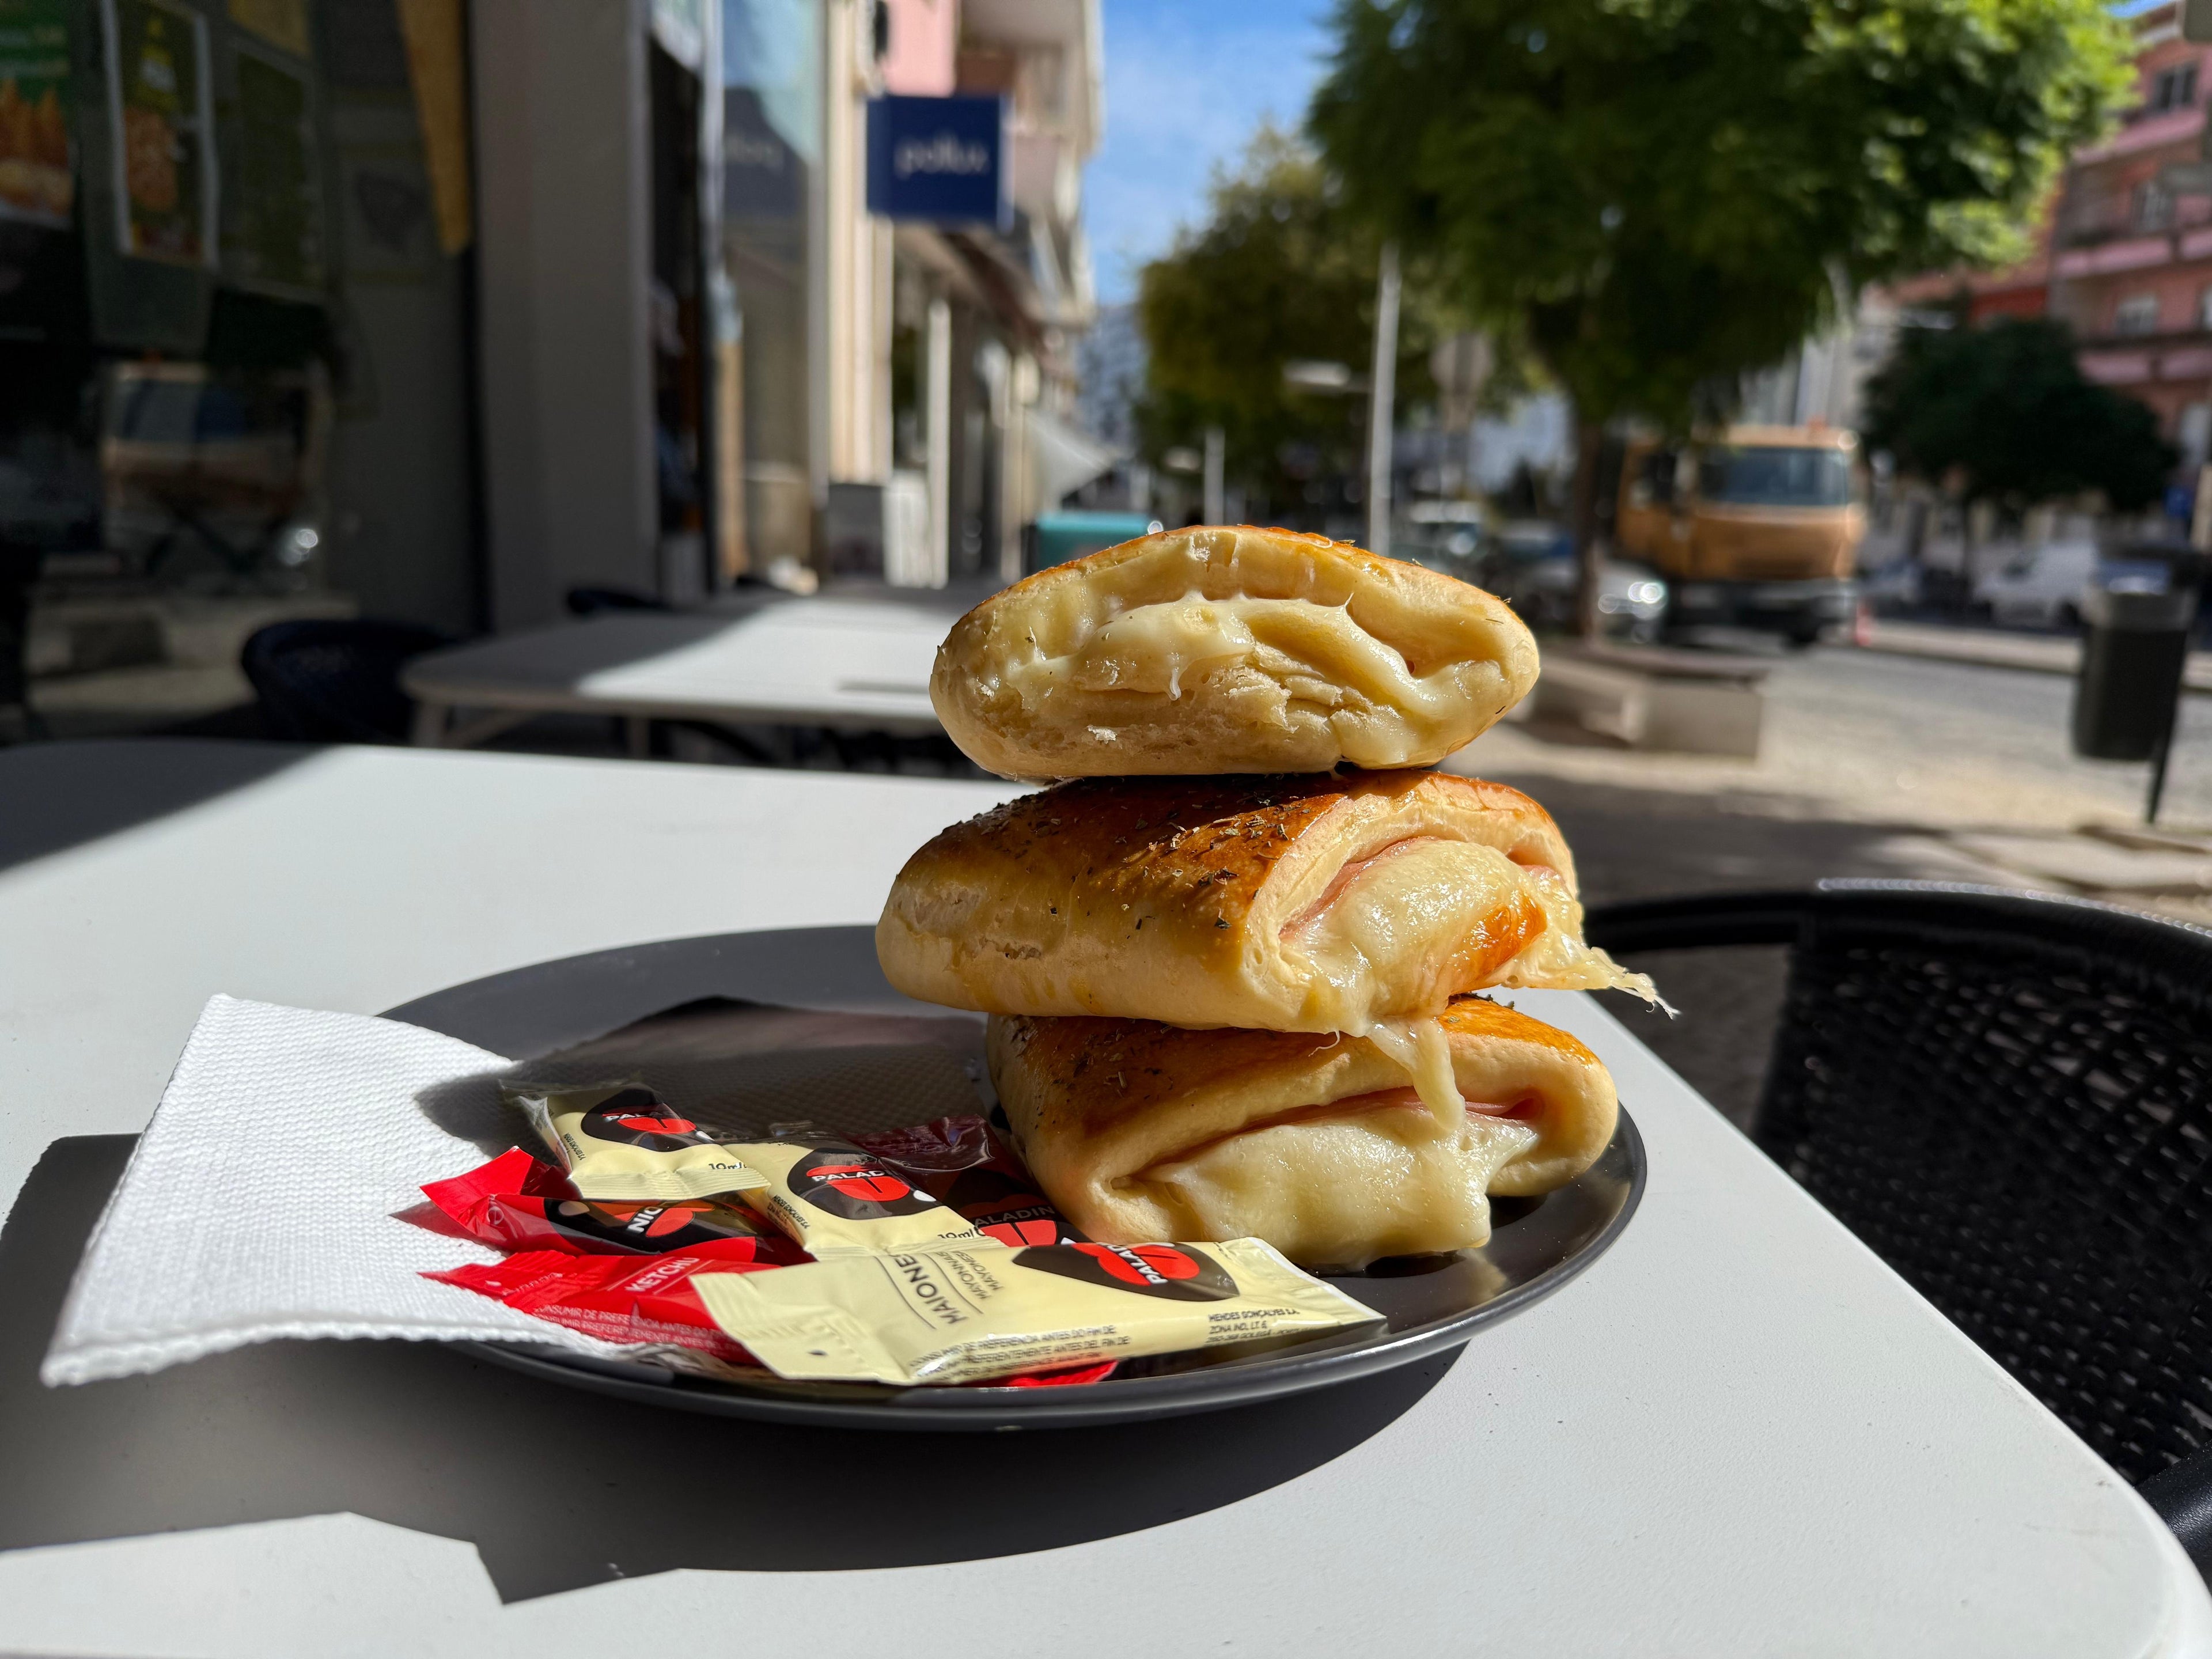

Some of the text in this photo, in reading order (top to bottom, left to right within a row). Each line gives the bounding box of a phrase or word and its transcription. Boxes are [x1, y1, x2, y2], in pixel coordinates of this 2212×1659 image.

[812, 1170, 885, 1181] PALAD
[974, 1206, 1055, 1228] ALADIN
[625, 1257, 700, 1293] KETCHU
